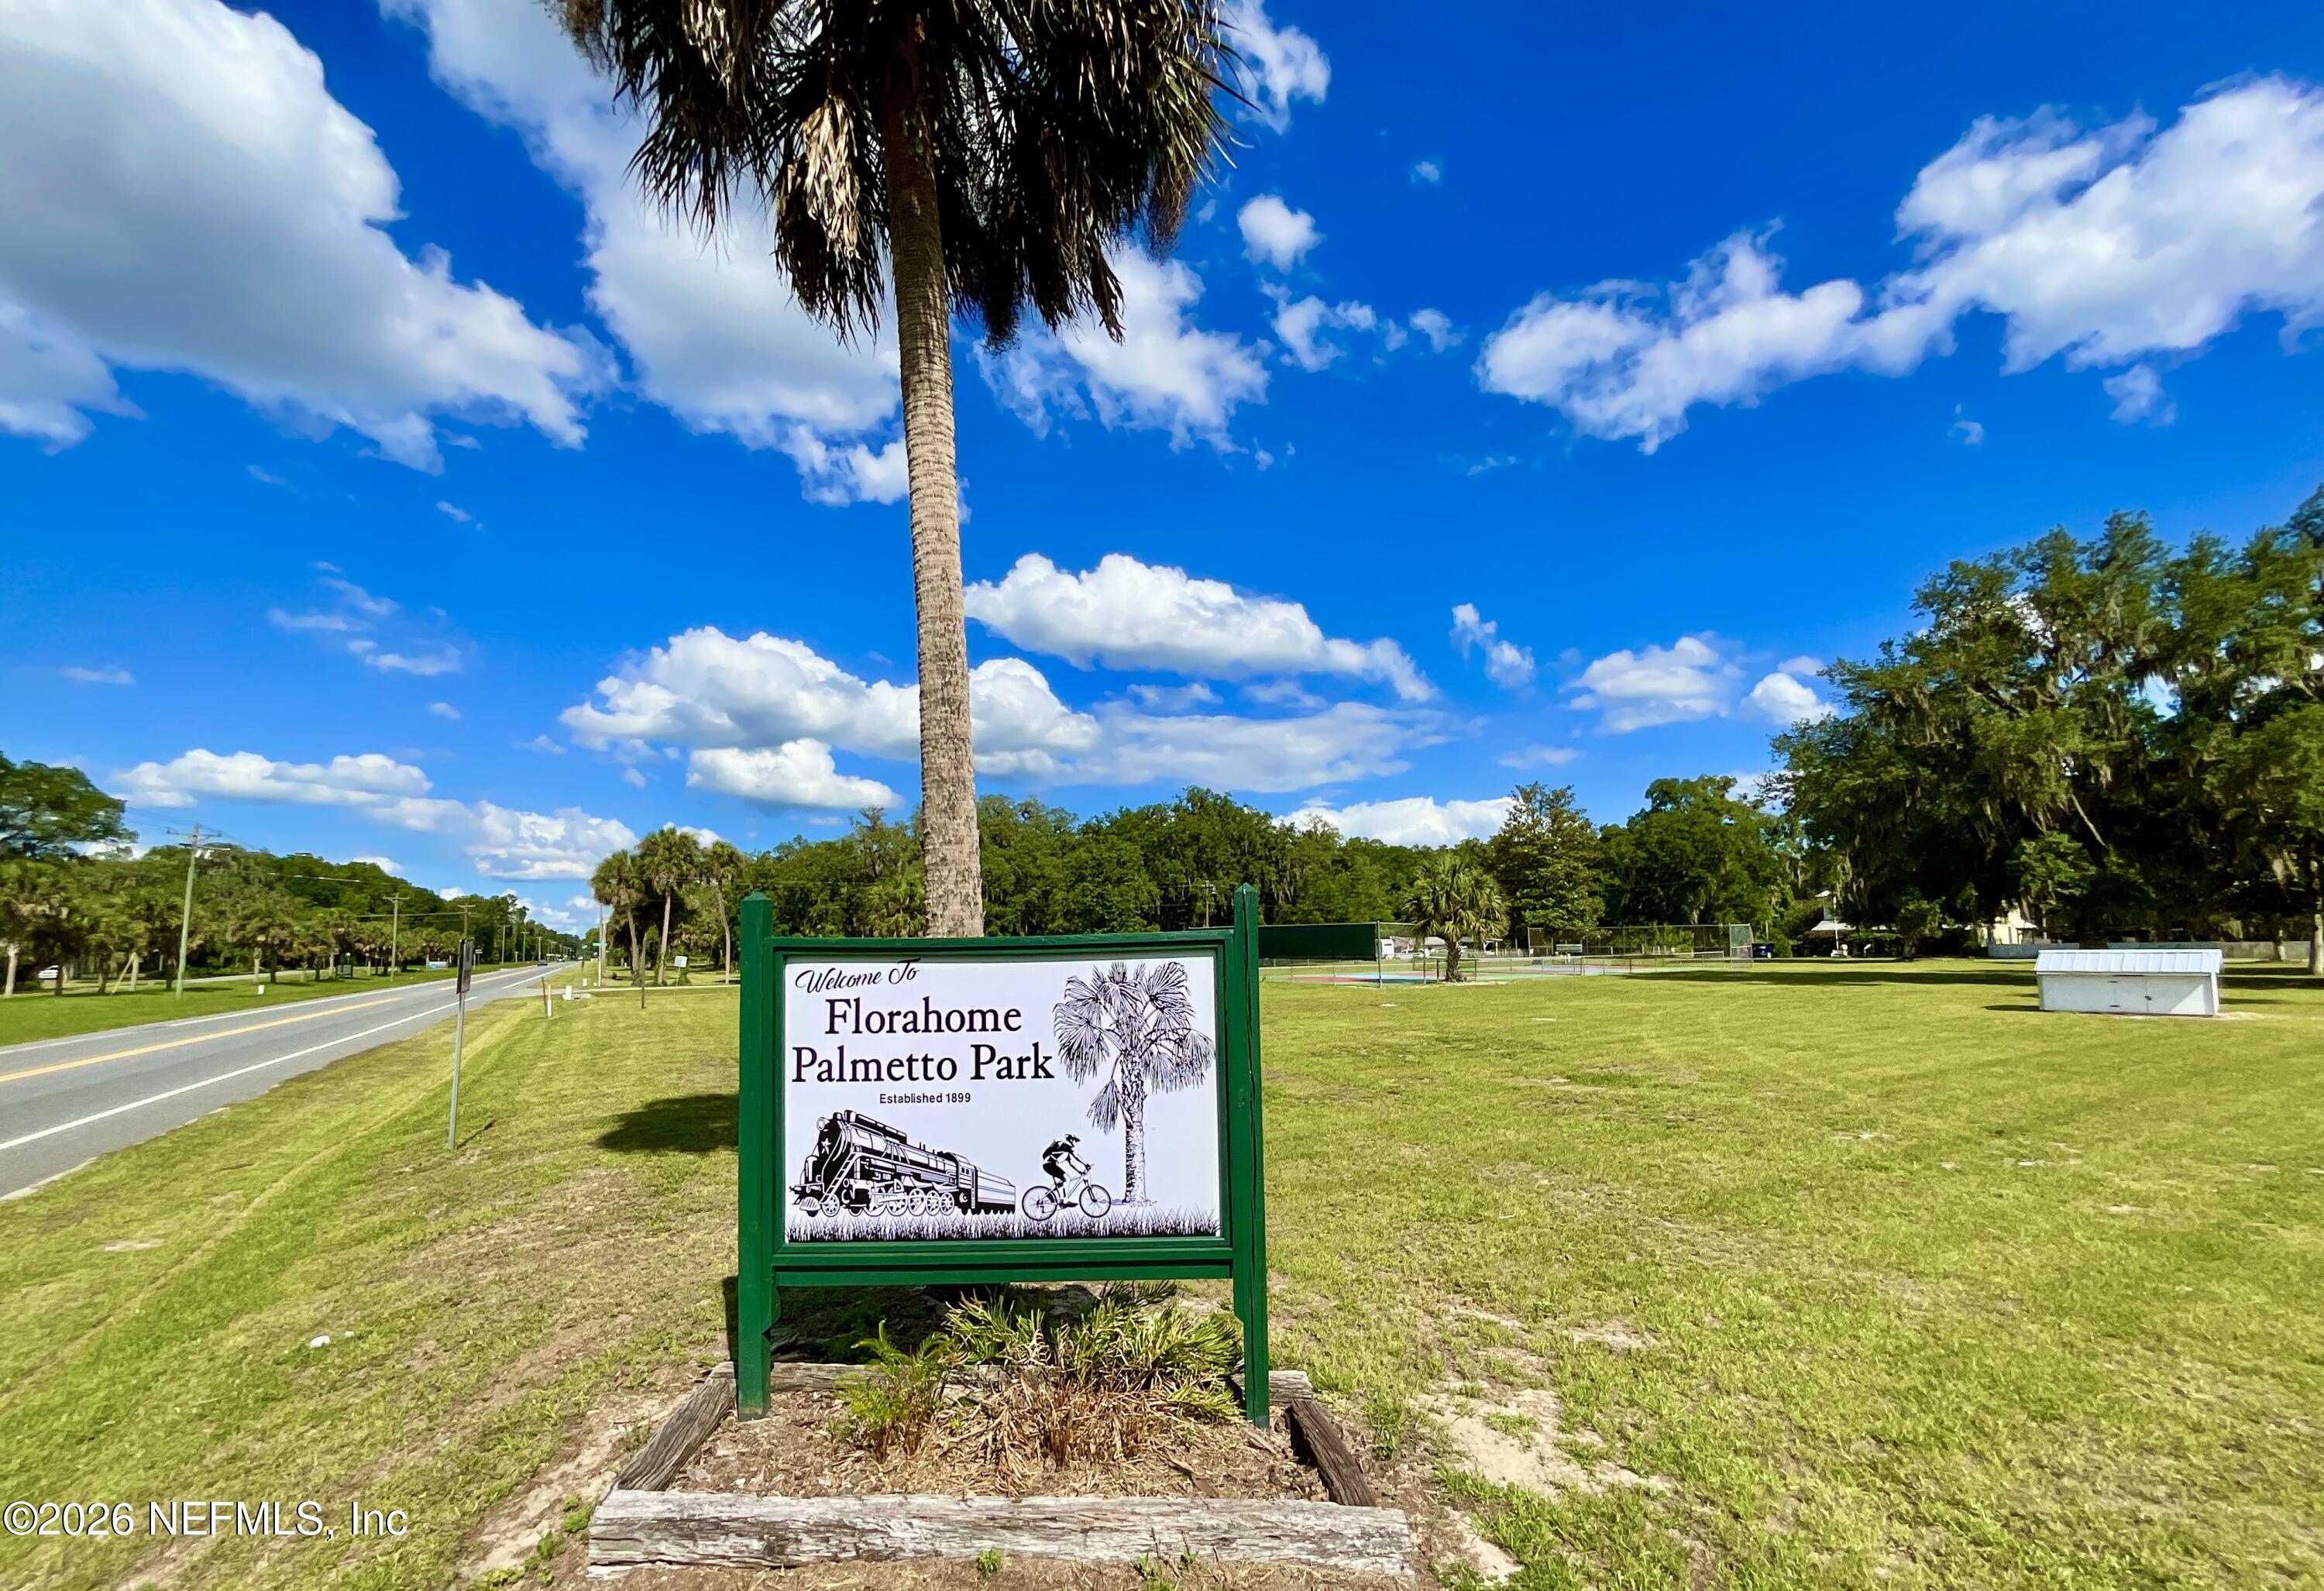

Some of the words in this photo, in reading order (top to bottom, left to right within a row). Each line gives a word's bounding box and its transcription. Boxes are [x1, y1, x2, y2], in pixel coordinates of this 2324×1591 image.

[795, 967, 882, 994] Welcome
[889, 957, 921, 985] To
[824, 995, 1023, 1035] Florahome
[792, 1044, 958, 1083] Palmetto
[970, 1041, 1056, 1081] Park
[879, 1092, 944, 1105] Established
[945, 1092, 971, 1103] 1899
